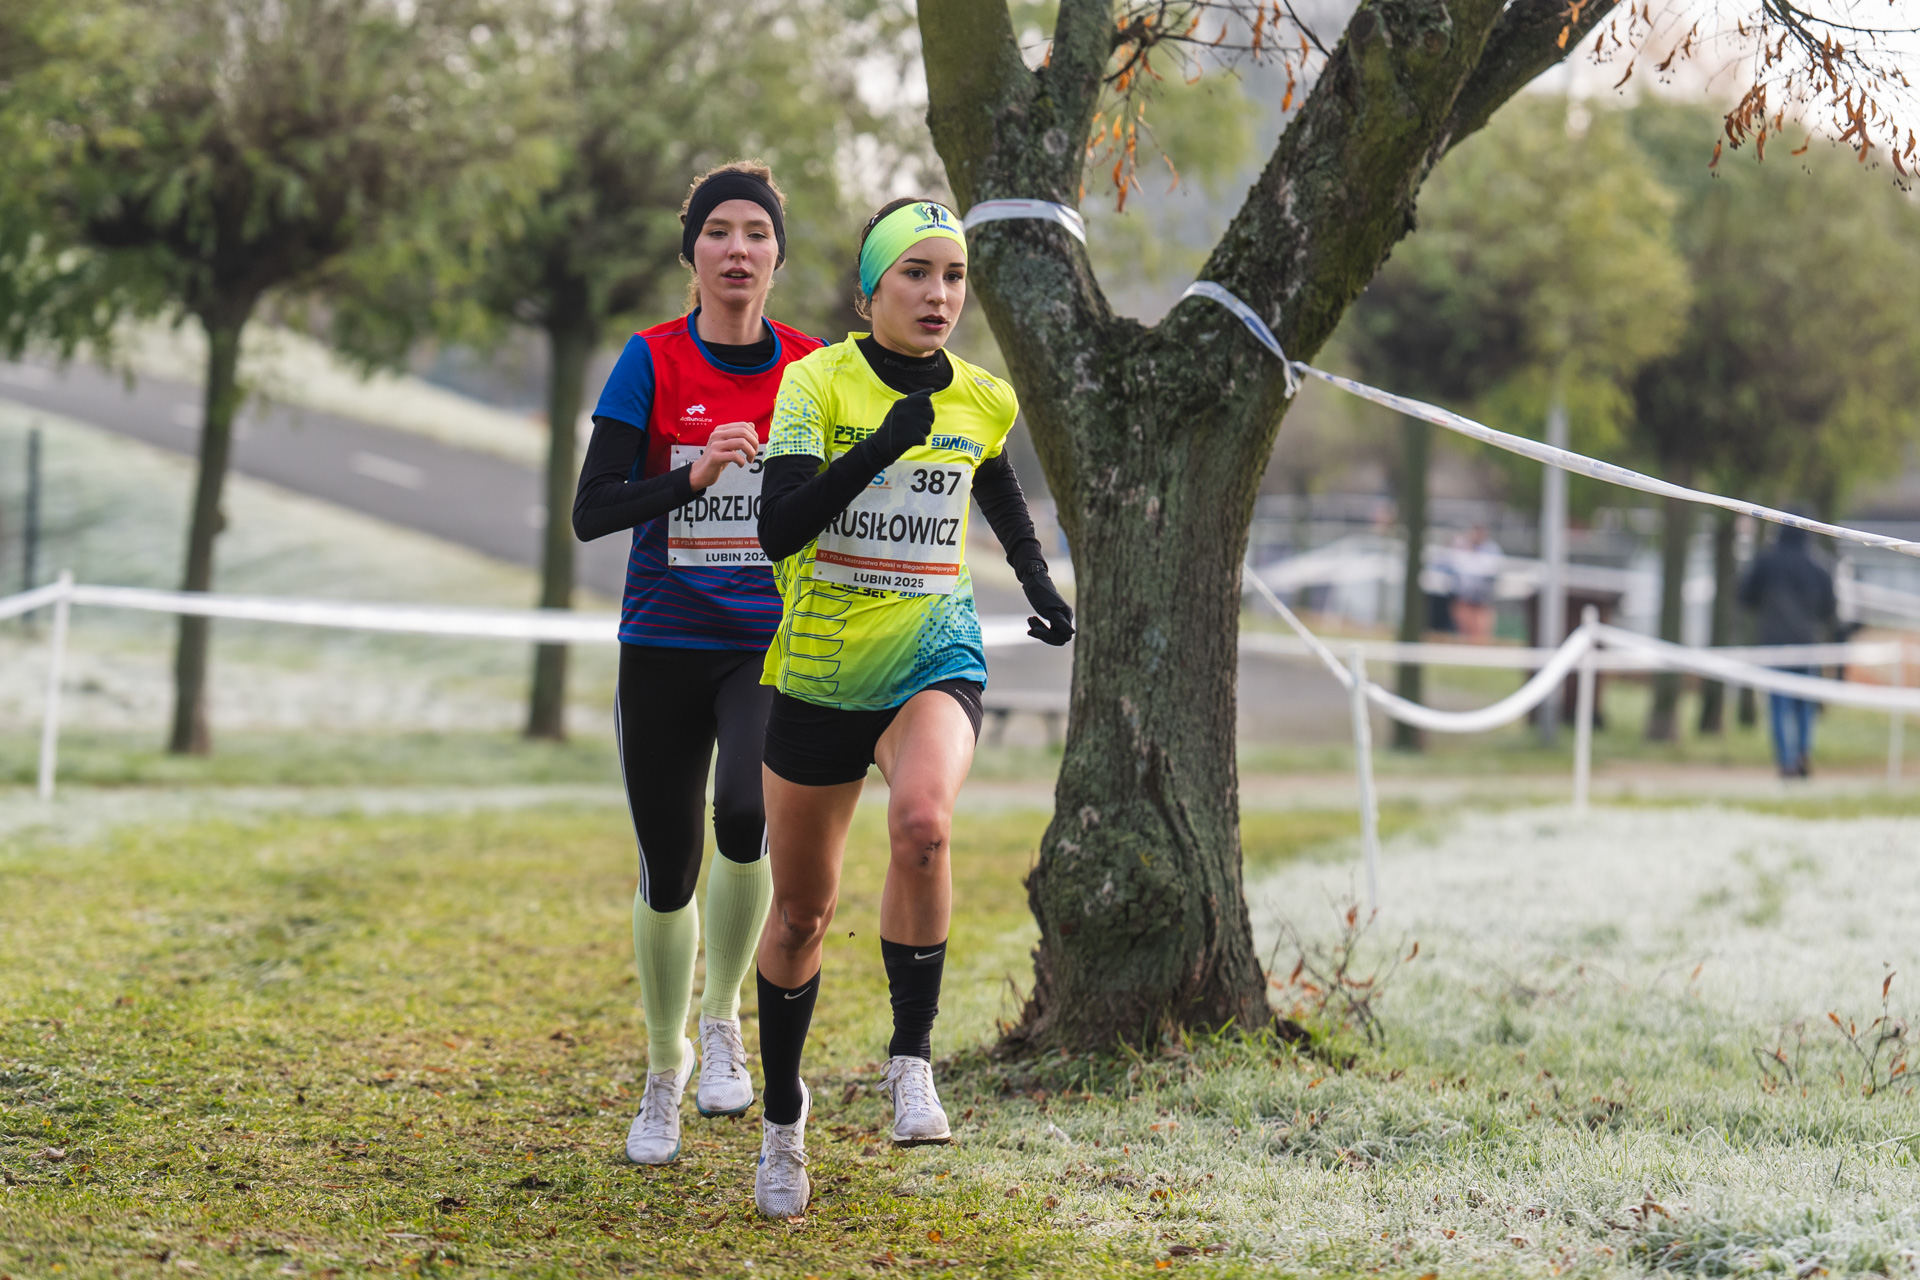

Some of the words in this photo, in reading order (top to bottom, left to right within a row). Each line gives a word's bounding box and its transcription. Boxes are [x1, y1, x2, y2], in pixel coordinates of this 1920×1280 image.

[931, 435, 984, 459] SONAROL
[910, 468, 962, 496] 387
[825, 510, 960, 546] RUSIŁOWICZ
[705, 553, 741, 562] LUBIN
[744, 552, 769, 562] 202
[844, 557, 878, 567] Mistrzostwa
[902, 563, 925, 572] Biegach
[853, 572, 892, 585] LUBIN
[894, 576, 924, 588] 2025
